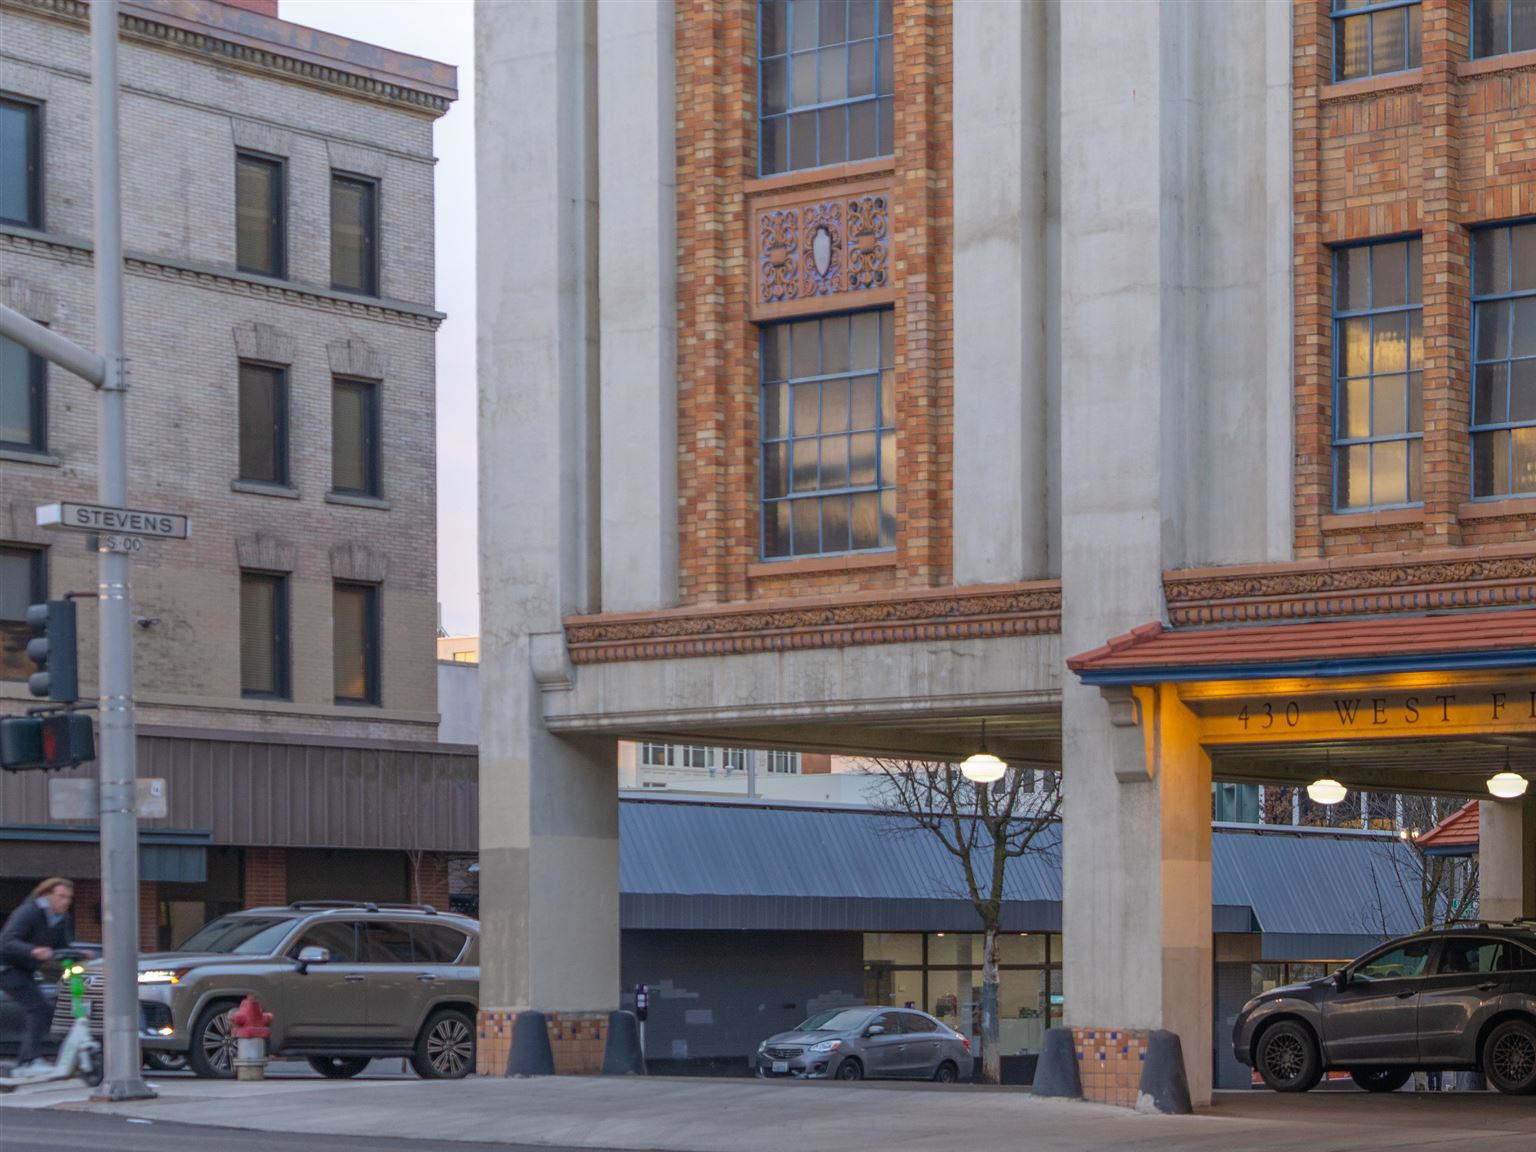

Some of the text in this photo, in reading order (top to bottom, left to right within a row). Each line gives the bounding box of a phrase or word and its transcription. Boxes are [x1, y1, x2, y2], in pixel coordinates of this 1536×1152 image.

[76, 508, 173, 533] STEVENS
[1237, 701, 1300, 730] 430
[1334, 694, 1456, 726] WEST
